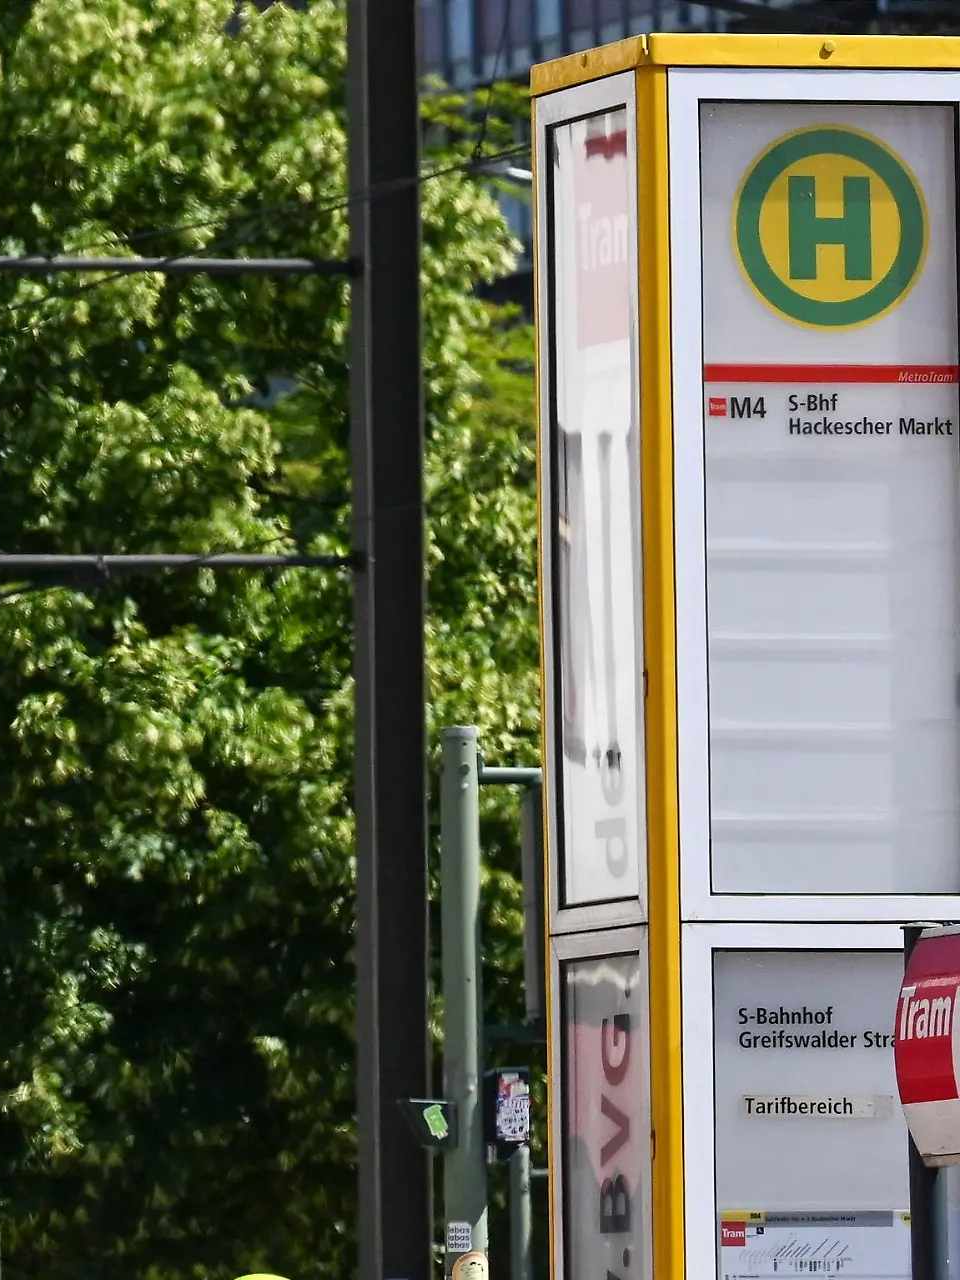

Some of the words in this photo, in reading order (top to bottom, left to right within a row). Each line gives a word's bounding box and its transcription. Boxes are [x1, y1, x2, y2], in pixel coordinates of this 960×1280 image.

[788, 176, 872, 281] H
[898, 372, 953, 383] MetroTram
[730, 397, 767, 419] M4
[789, 393, 838, 411] S-Bhf
[789, 417, 893, 435] Hackescher
[899, 417, 953, 435] Markt
[738, 1006, 833, 1024] S-Bahnhof
[899, 986, 952, 1041] Tram
[739, 1030, 857, 1048] Greifswalder
[745, 1097, 853, 1115] Tarifbereich
[722, 1228, 745, 1239] Tram
